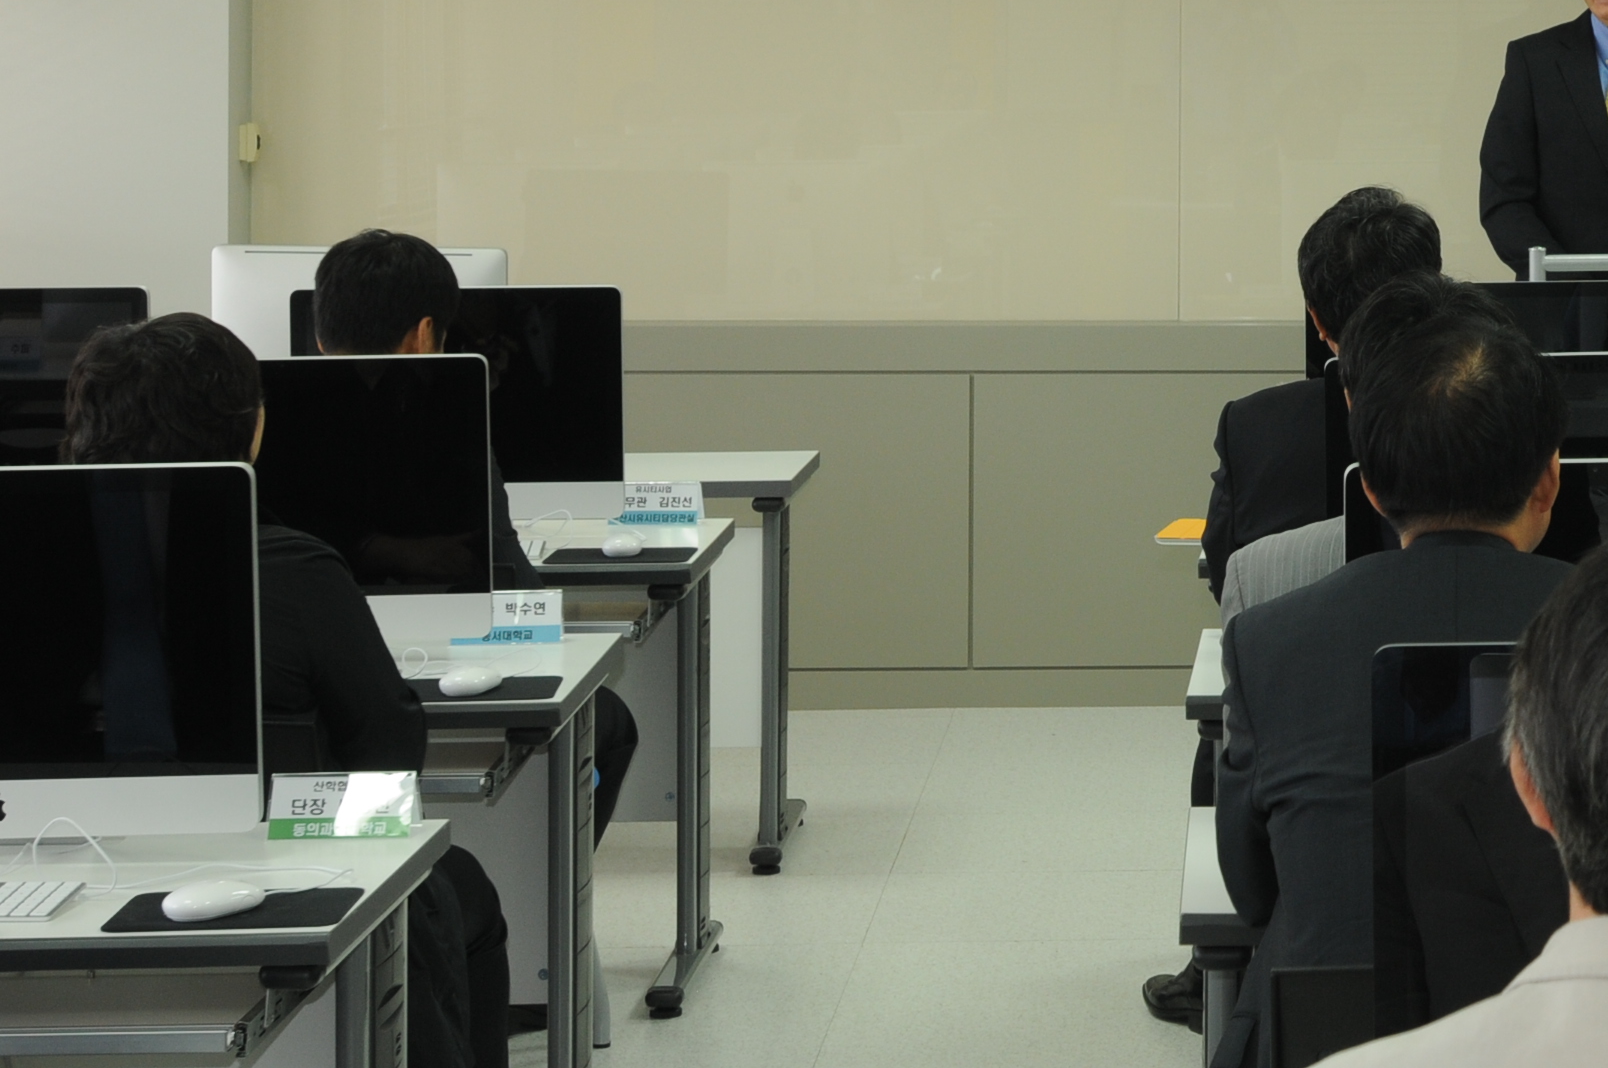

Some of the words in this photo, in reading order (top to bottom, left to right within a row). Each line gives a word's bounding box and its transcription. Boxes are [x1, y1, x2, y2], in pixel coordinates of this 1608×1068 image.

[624, 497, 647, 508] 무관
[659, 497, 692, 508] 김진선
[619, 513, 695, 524] 산시유시티담당관실
[505, 602, 546, 616] 박수연
[291, 798, 327, 816] 단장
